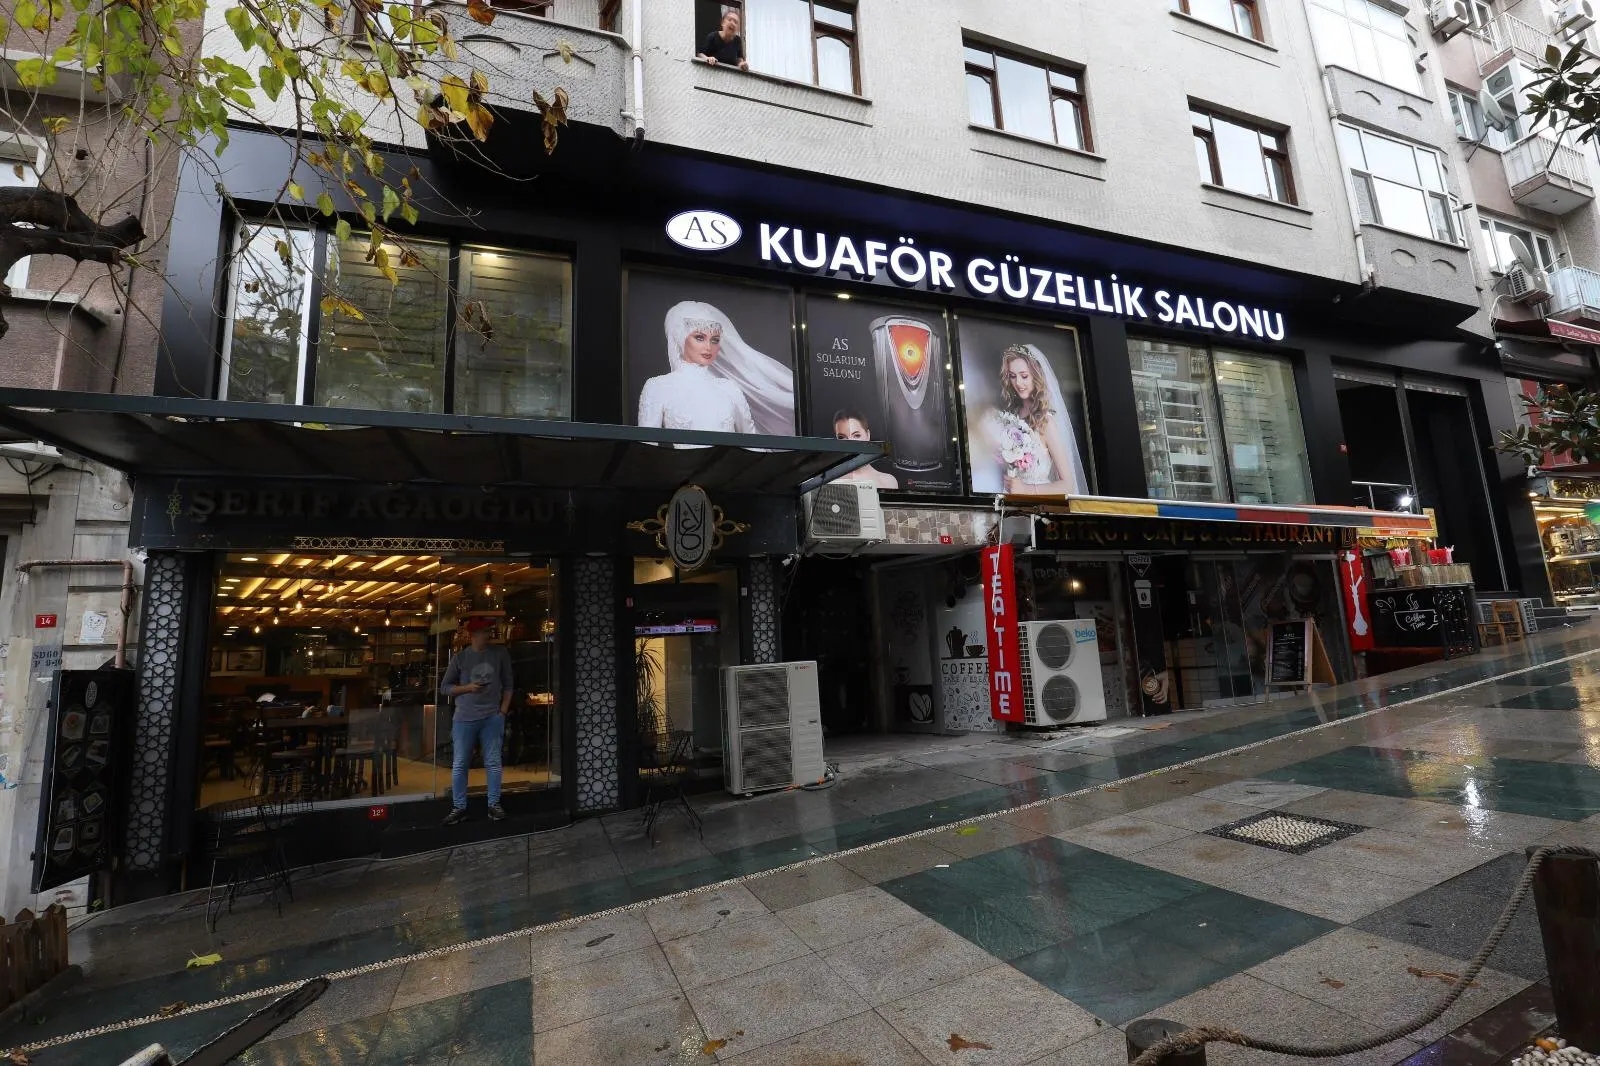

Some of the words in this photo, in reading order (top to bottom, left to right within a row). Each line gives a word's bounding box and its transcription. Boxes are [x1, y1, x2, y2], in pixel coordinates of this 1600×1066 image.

[683, 215, 728, 246] AS
[760, 223, 956, 289] KUAFÖR
[966, 254, 1148, 319] GÜZELLİK
[1154, 289, 1286, 341] SALONU
[832, 337, 849, 351] AS
[816, 353, 866, 367] SOLARIUM
[823, 367, 862, 380] SALONU
[1216, 522, 1337, 546] RESTAURANT
[41, 617, 51, 625] 14
[1075, 627, 1096, 638] beko
